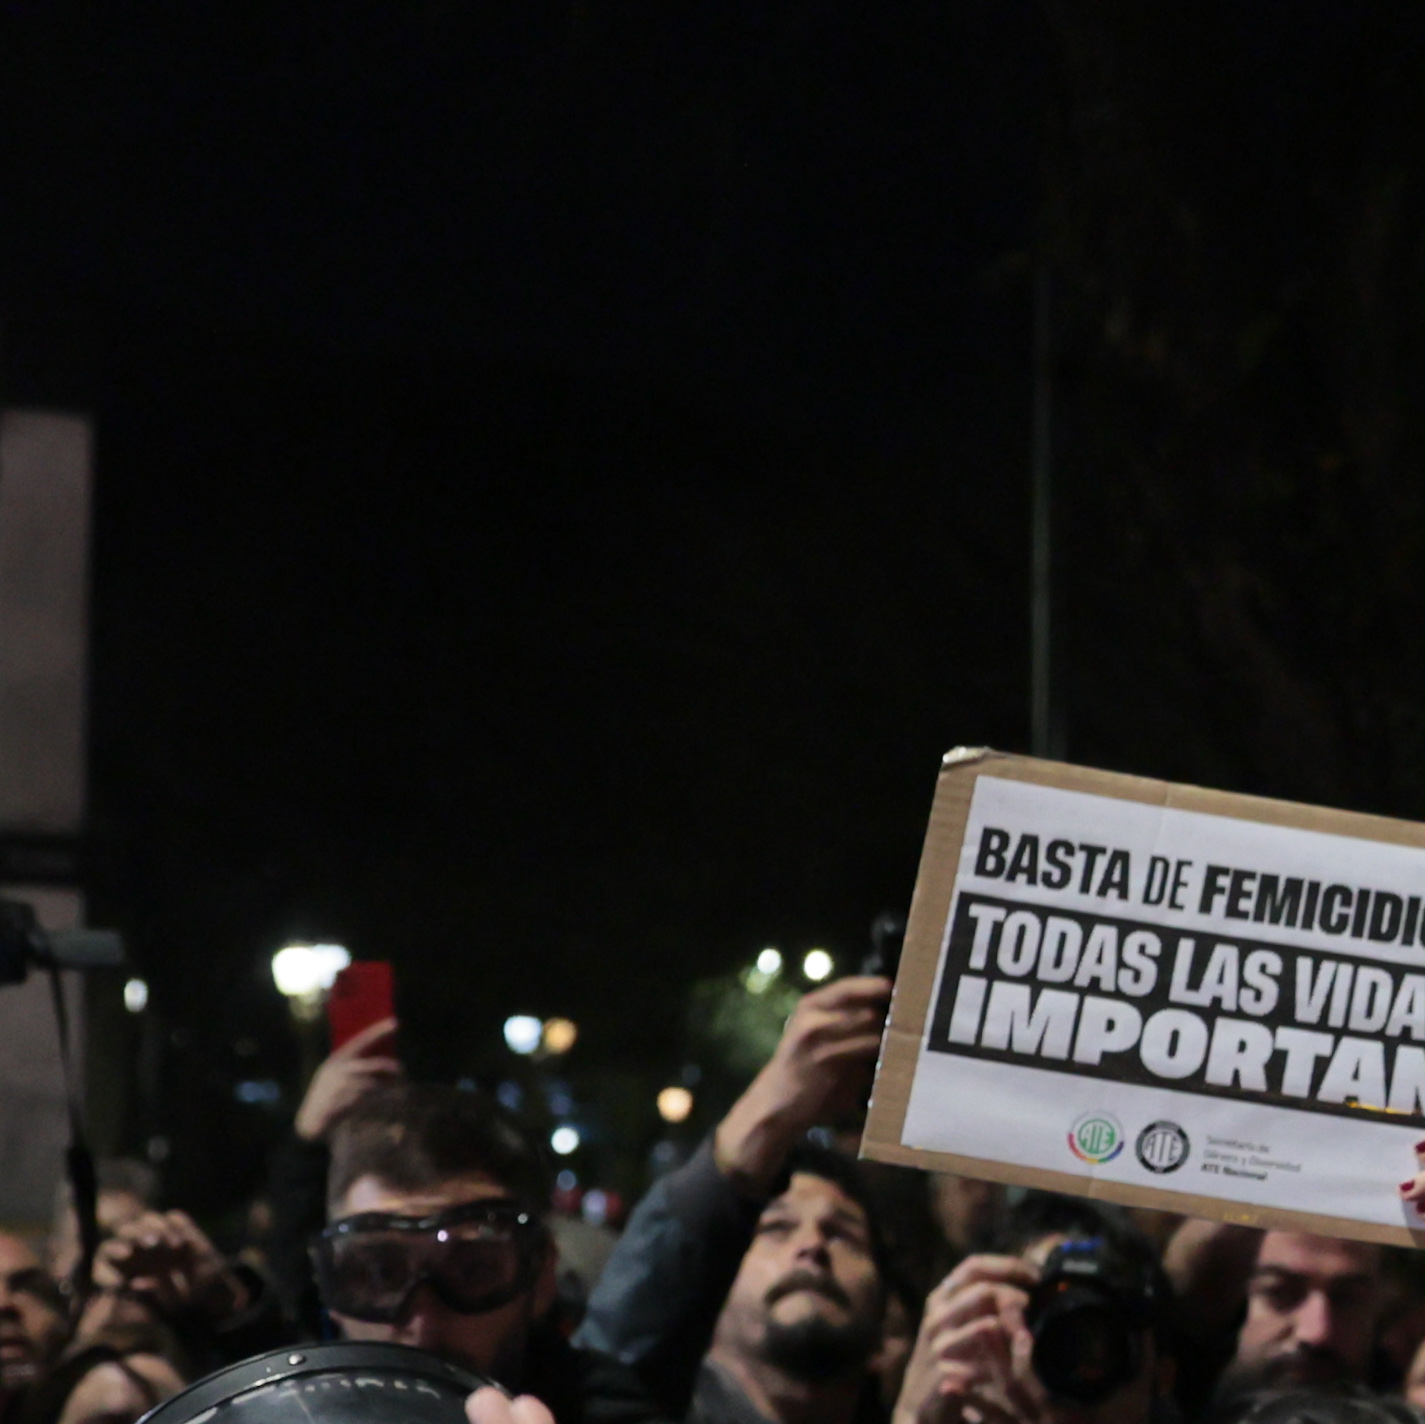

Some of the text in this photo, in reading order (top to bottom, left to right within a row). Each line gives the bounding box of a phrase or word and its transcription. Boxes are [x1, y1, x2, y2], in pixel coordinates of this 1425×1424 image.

[974, 826, 1131, 900] BASTA
[1142, 855, 1193, 910] DE
[967, 902, 1163, 998] TODAS
[1167, 936, 1284, 1018] LAS
